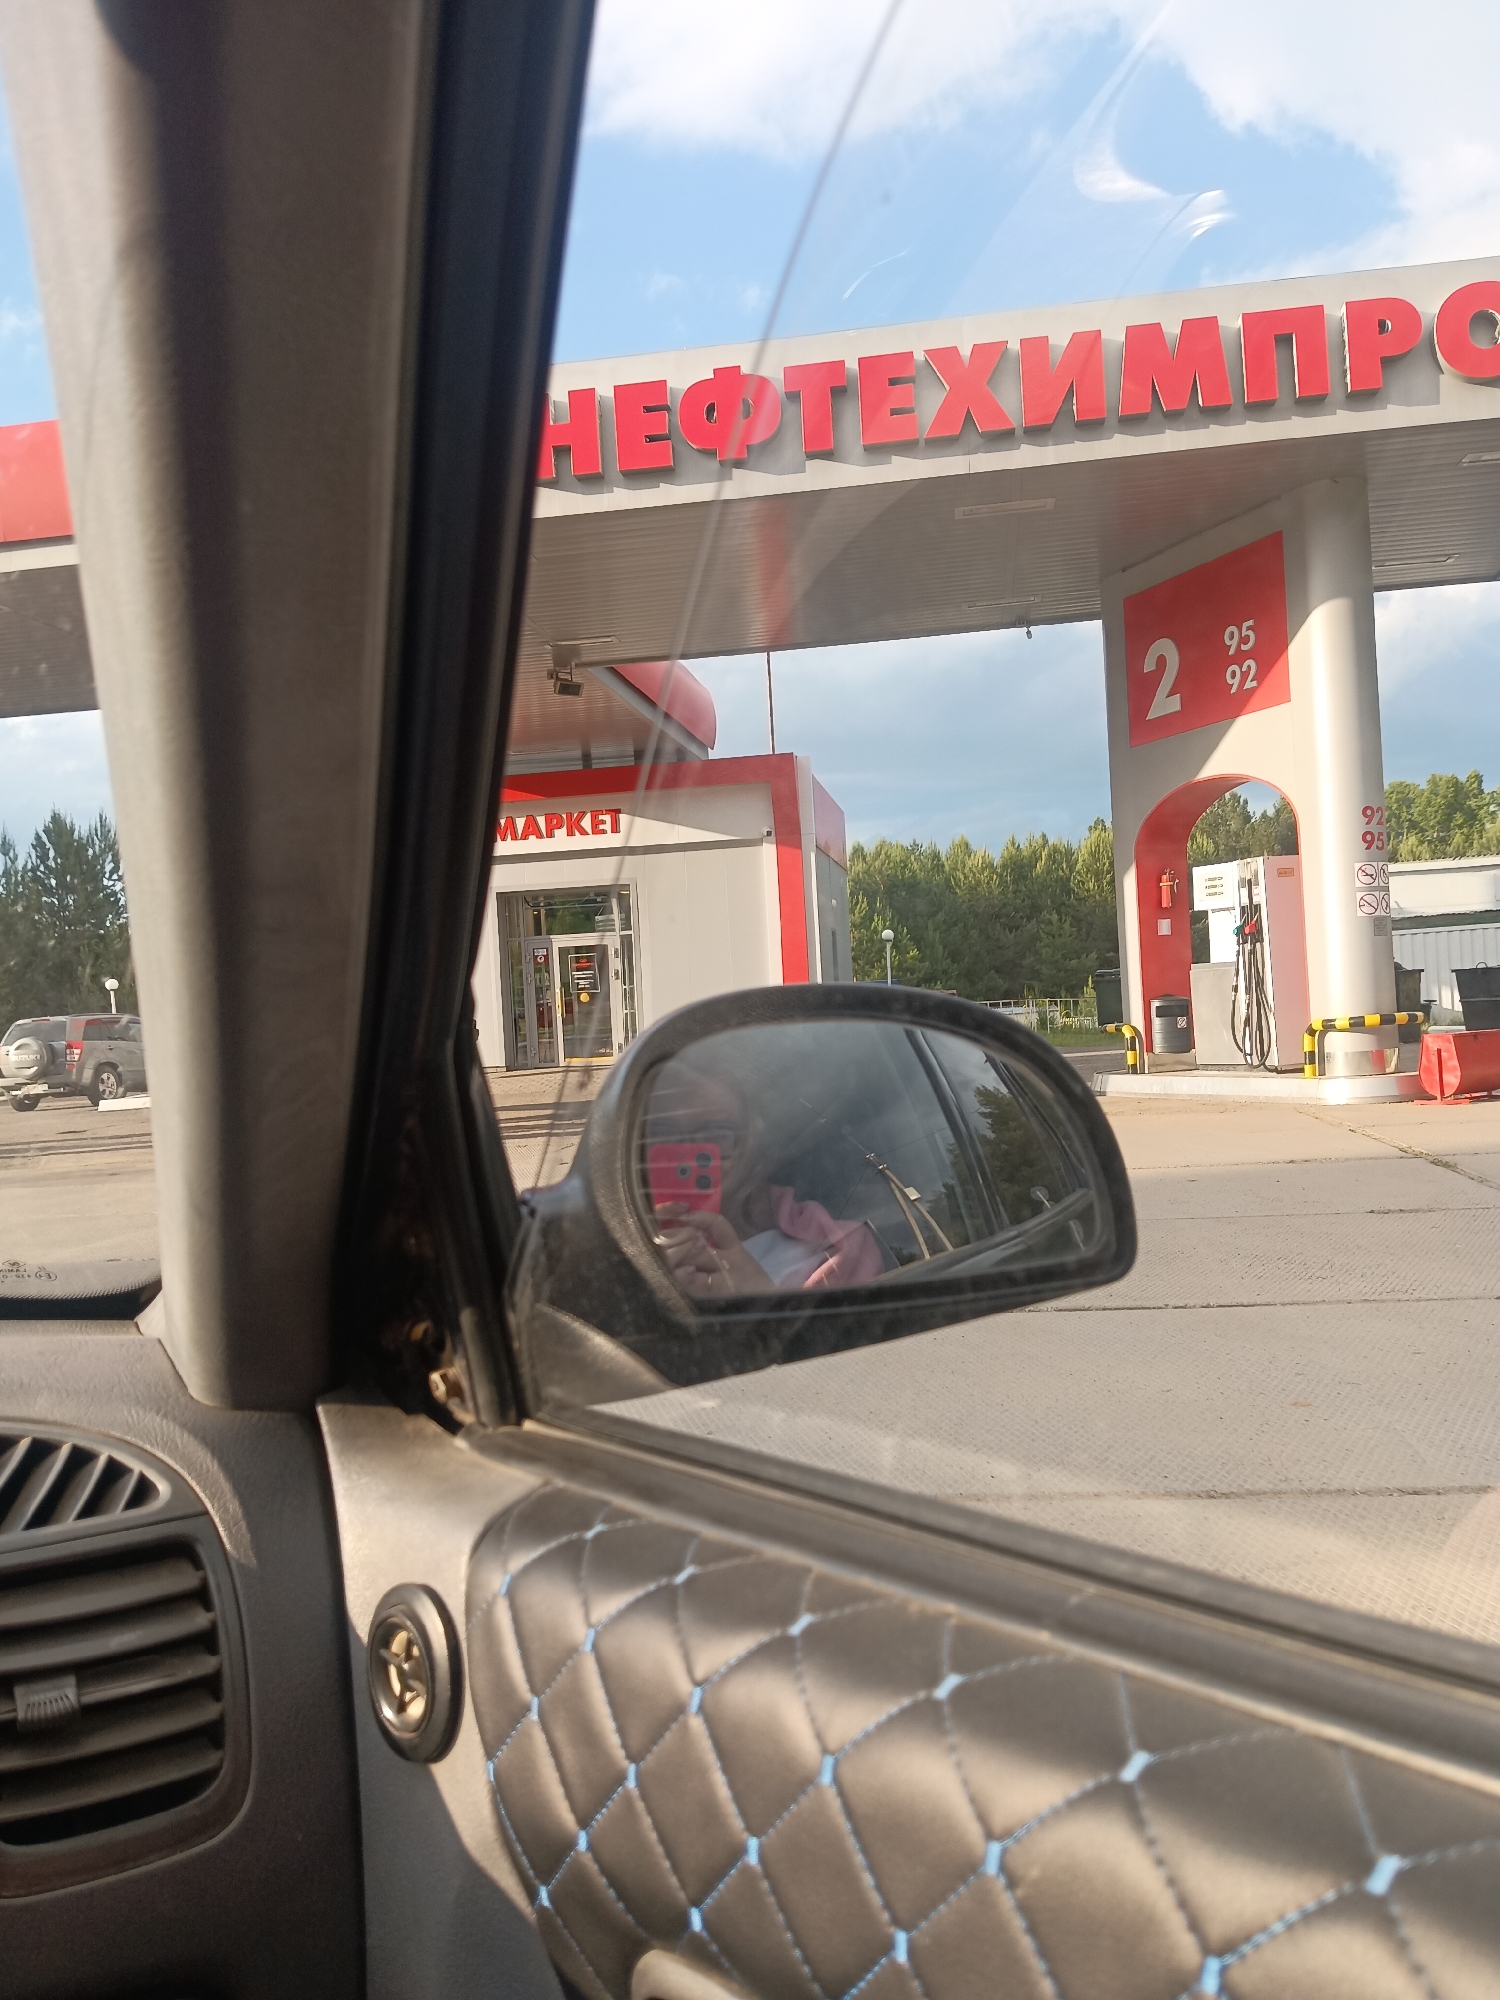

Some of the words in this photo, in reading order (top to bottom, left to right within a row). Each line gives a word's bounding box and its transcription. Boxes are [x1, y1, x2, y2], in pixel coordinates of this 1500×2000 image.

[535, 281, 1500, 480] НЕФТЕХИМПРО
[1223, 619, 1256, 656] 95
[1143, 637, 1182, 721] 2
[1225, 658, 1259, 694] 92
[495, 808, 622, 842] МАРКЕТ
[1361, 805, 1385, 826] 92
[1361, 830, 1385, 852] 95
